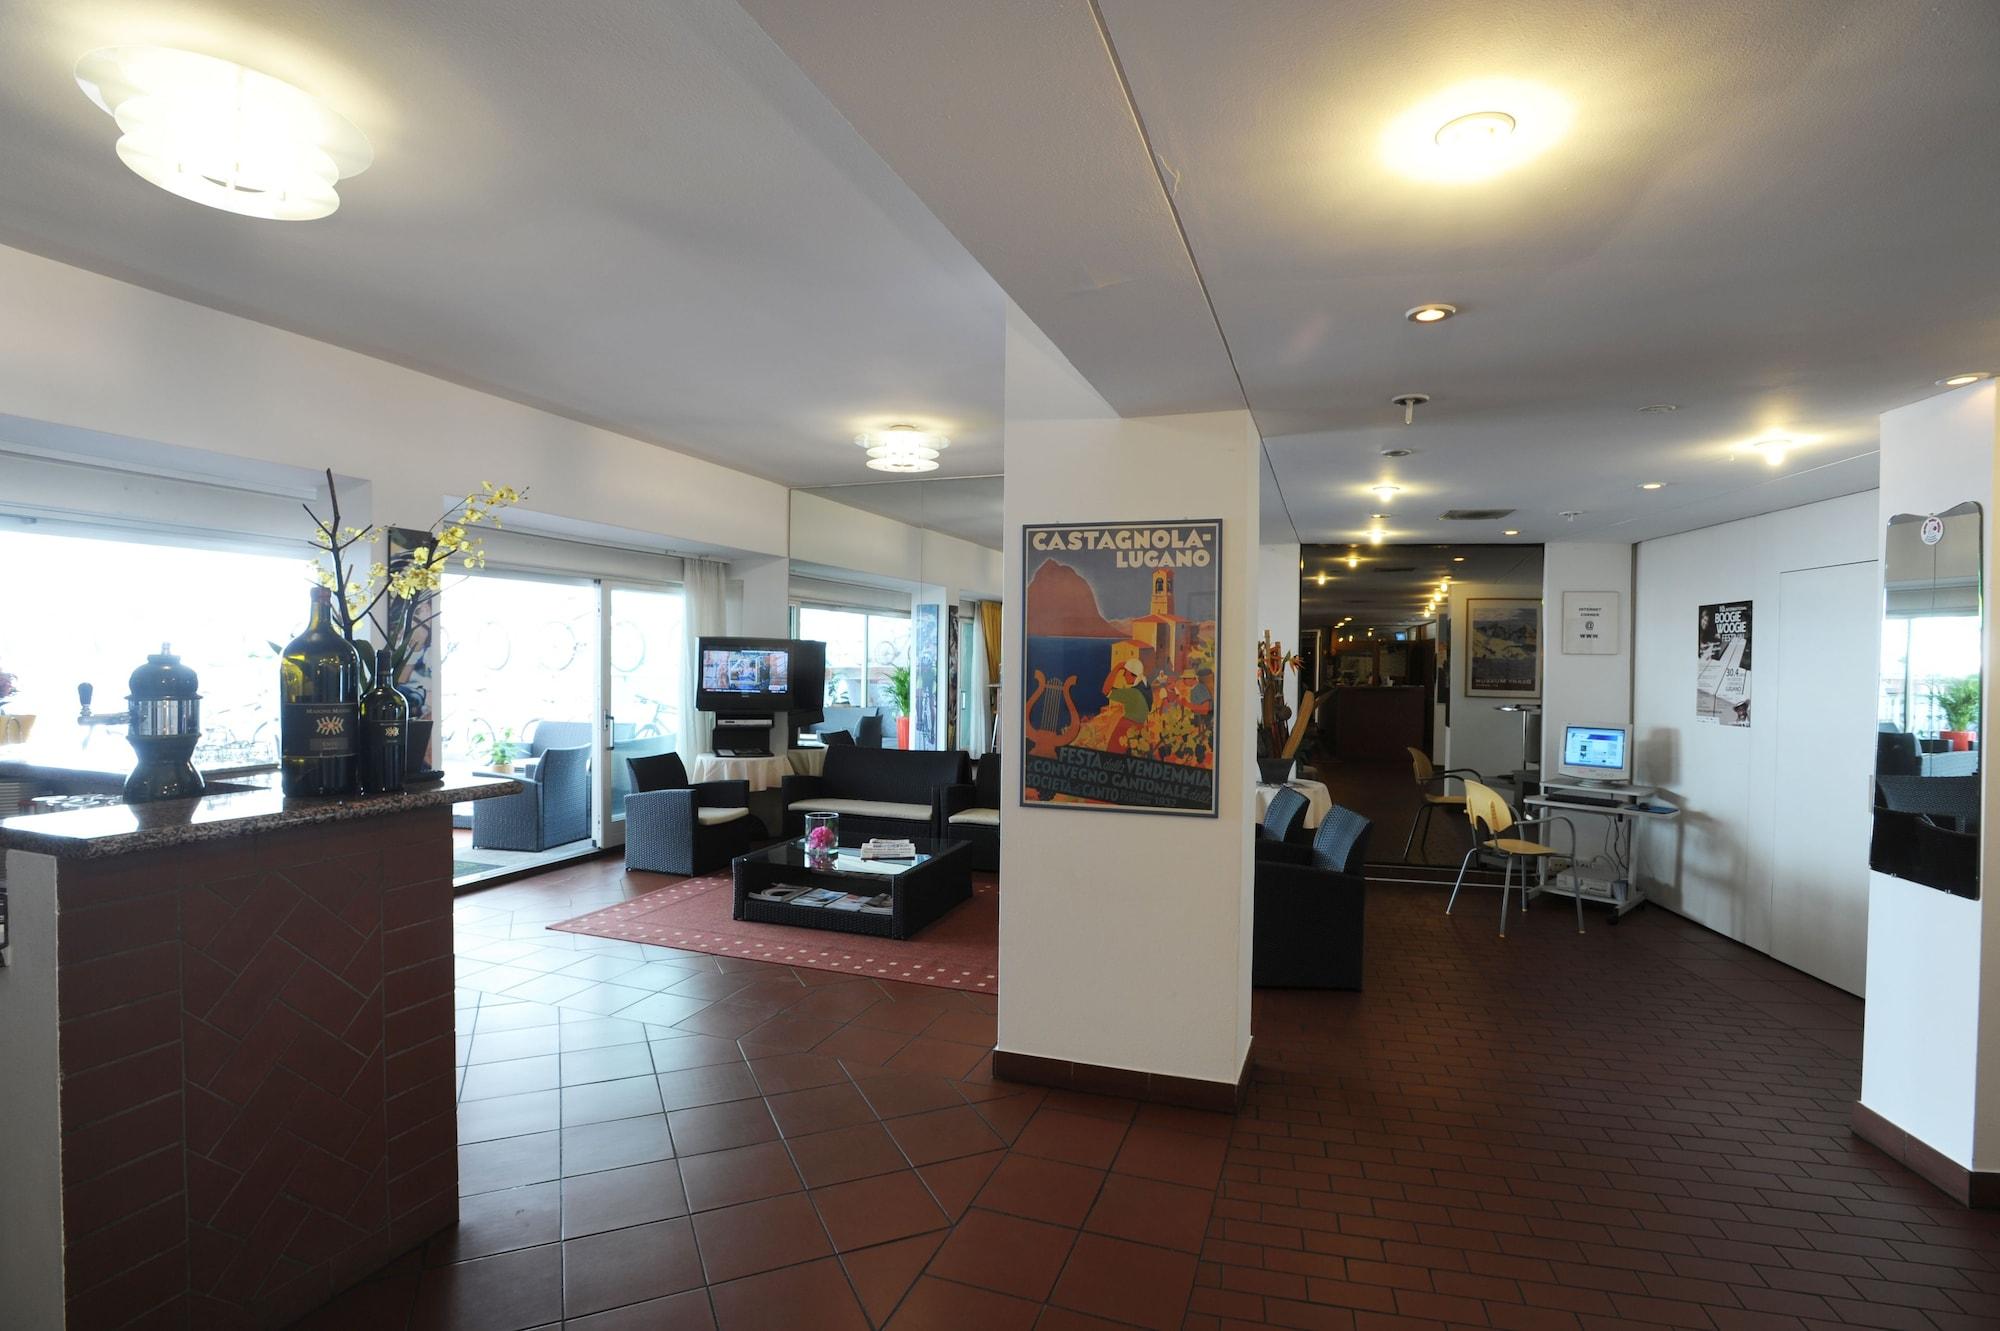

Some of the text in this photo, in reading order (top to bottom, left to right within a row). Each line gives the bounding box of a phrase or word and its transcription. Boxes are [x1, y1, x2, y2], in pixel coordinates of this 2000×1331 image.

[1032, 529, 1212, 550] CASTAGNOLA-
[1116, 550, 1211, 568] LUGANO
[1715, 610, 1742, 624] BOOGIE
[1716, 621, 1747, 634] WOOGIE
[1060, 747, 1102, 769] FESTA
[1126, 758, 1211, 788] VENDEMMIA
[1034, 760, 1108, 784] CONVEGNO
[1112, 774, 1190, 799] CANTONALE
[1082, 784, 1119, 802] CANTO
